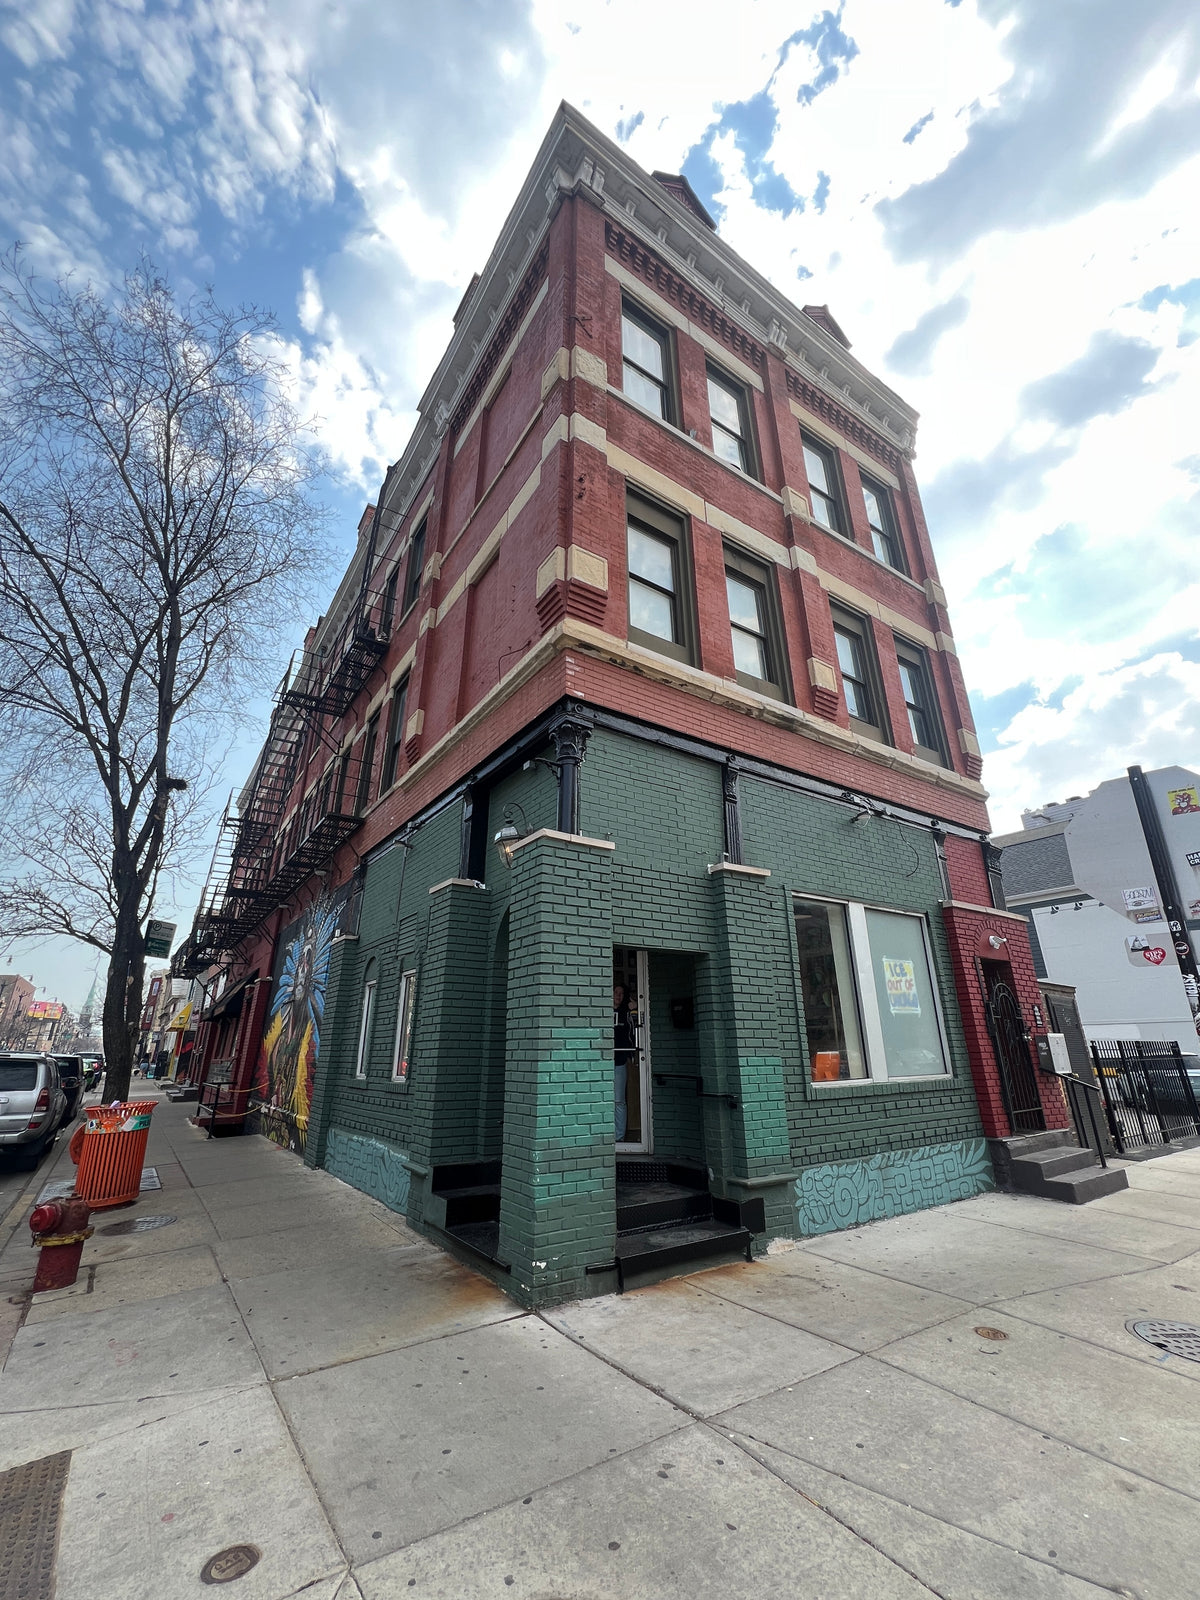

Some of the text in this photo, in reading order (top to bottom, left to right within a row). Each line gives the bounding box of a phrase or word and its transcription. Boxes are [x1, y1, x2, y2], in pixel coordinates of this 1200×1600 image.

[888, 962, 908, 978] ICE
[887, 978, 914, 992] OUT OF
